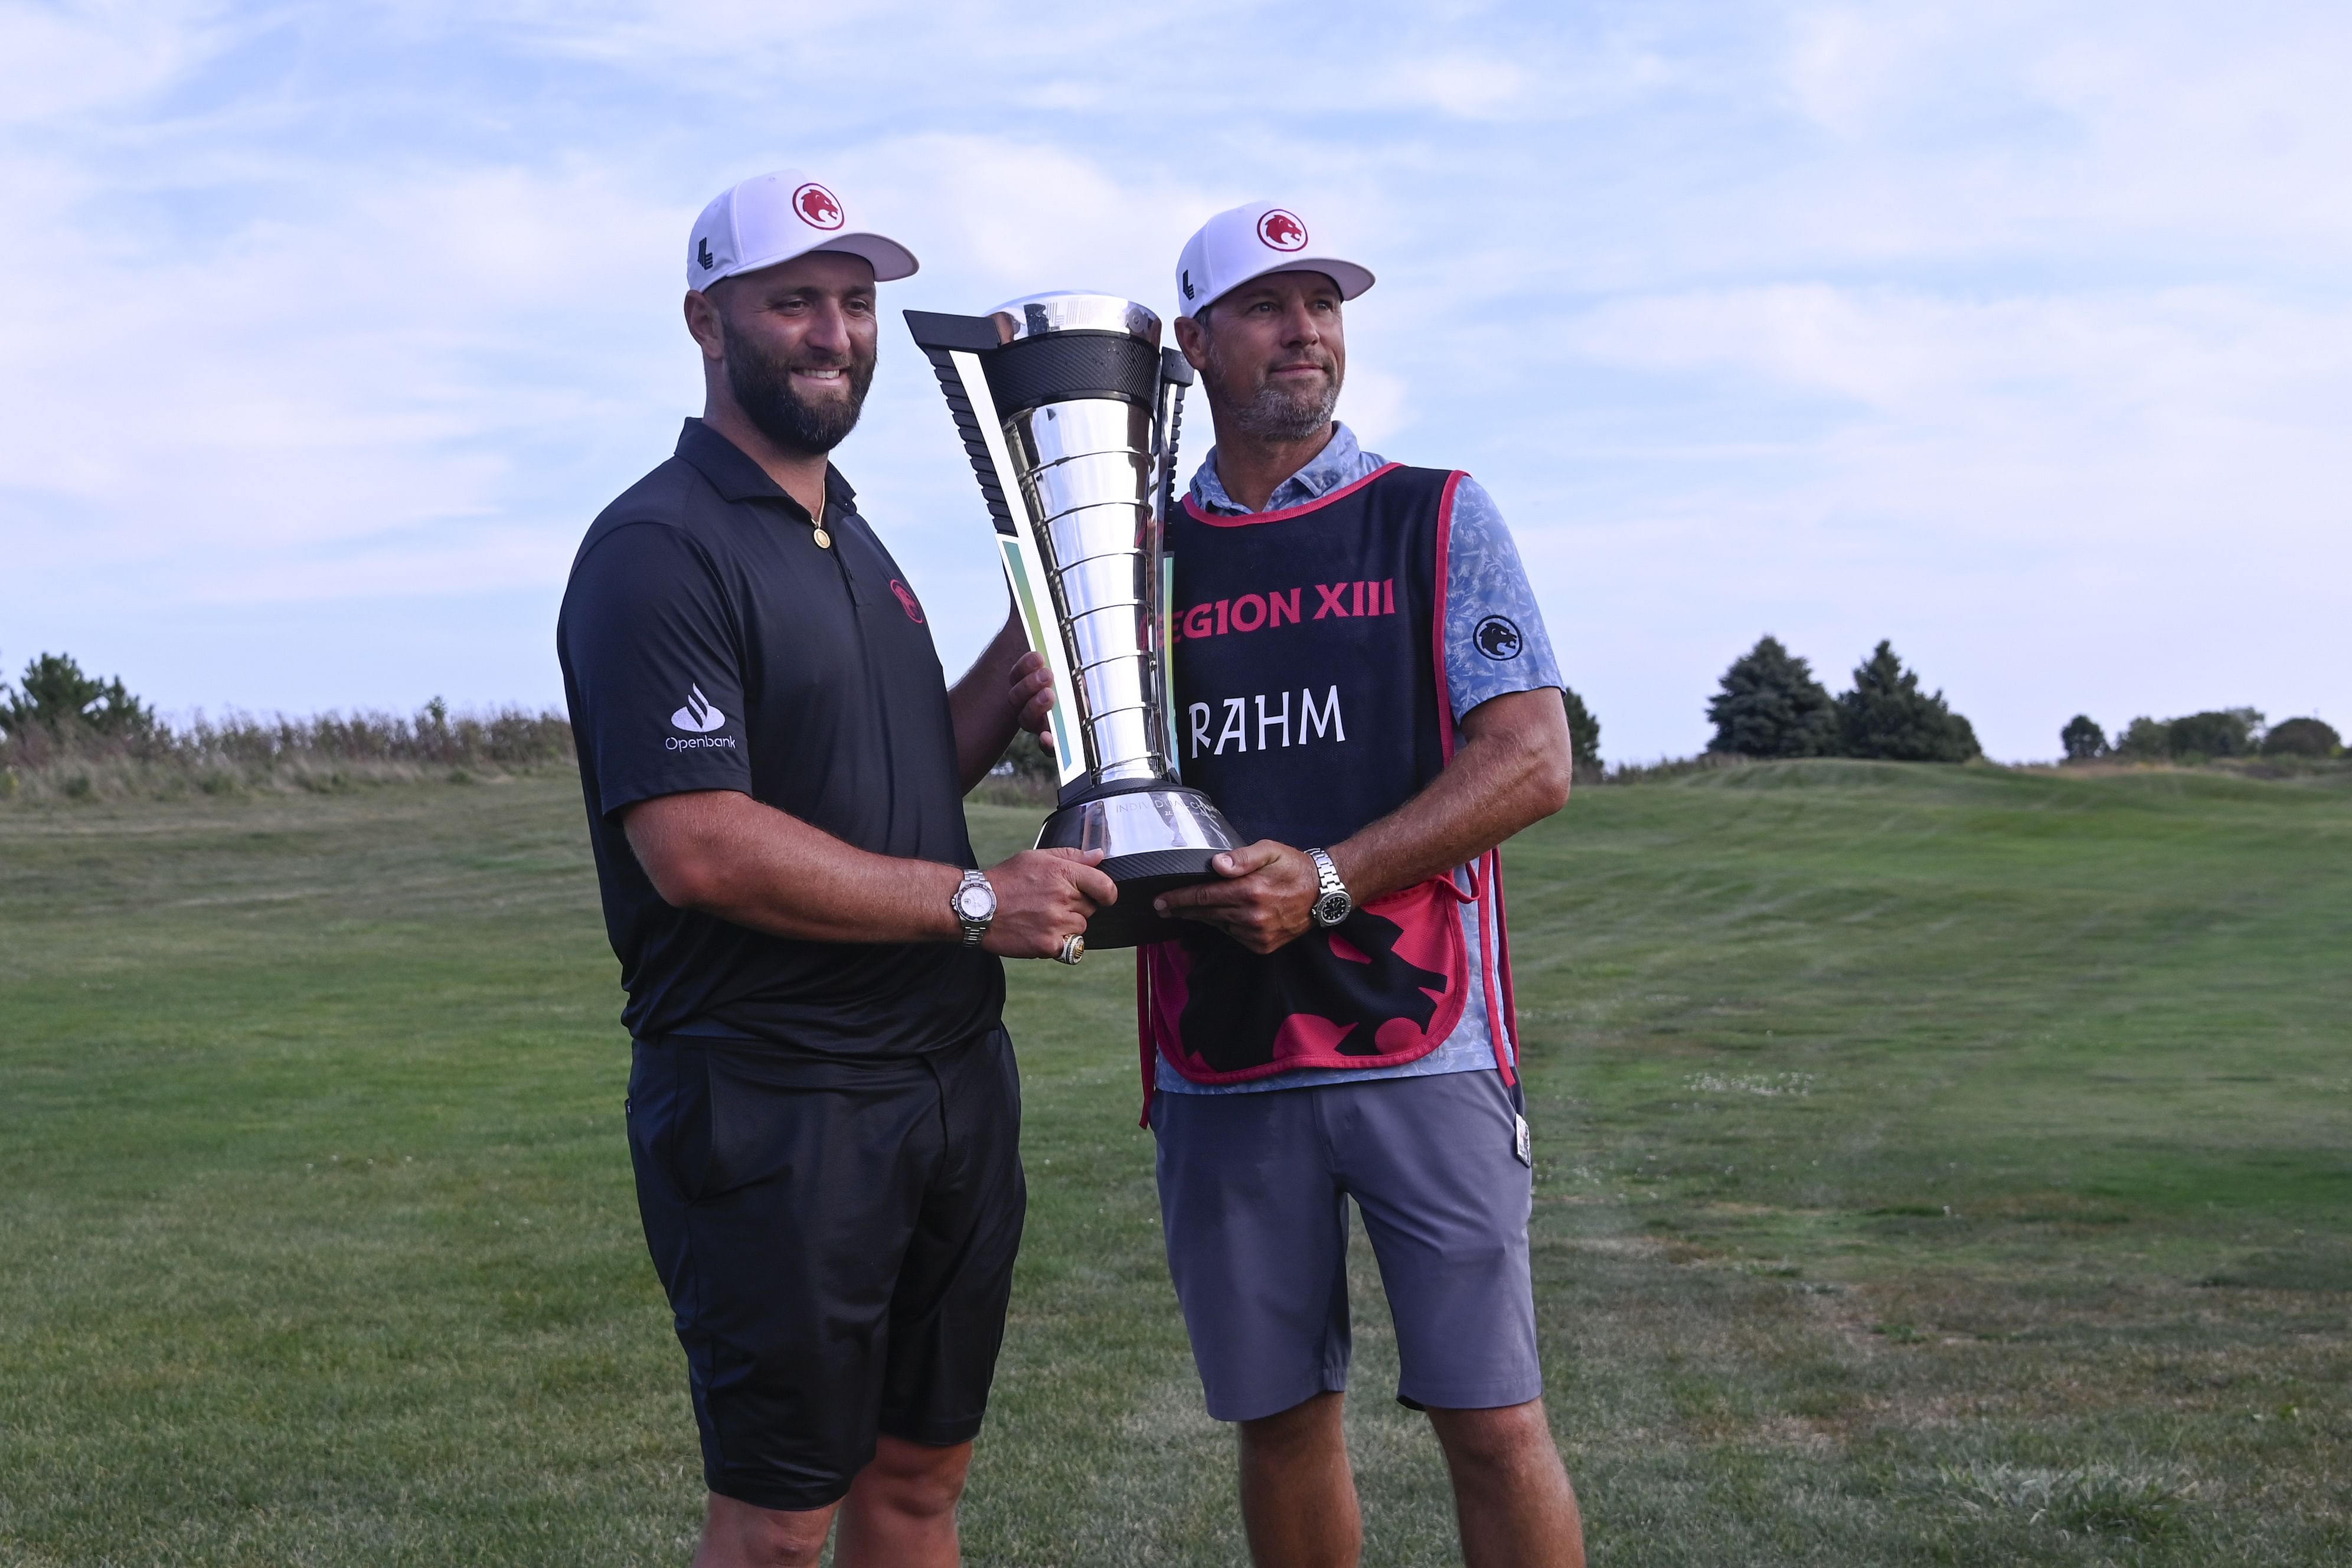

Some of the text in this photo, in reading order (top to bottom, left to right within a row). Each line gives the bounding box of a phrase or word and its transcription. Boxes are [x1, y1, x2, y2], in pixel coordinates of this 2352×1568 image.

[1172, 578, 1395, 643] EGION XIII
[1188, 685, 1346, 759] RAHM
[665, 735, 737, 753] Openbank
[1116, 800, 1189, 813] INDIVDUAL
